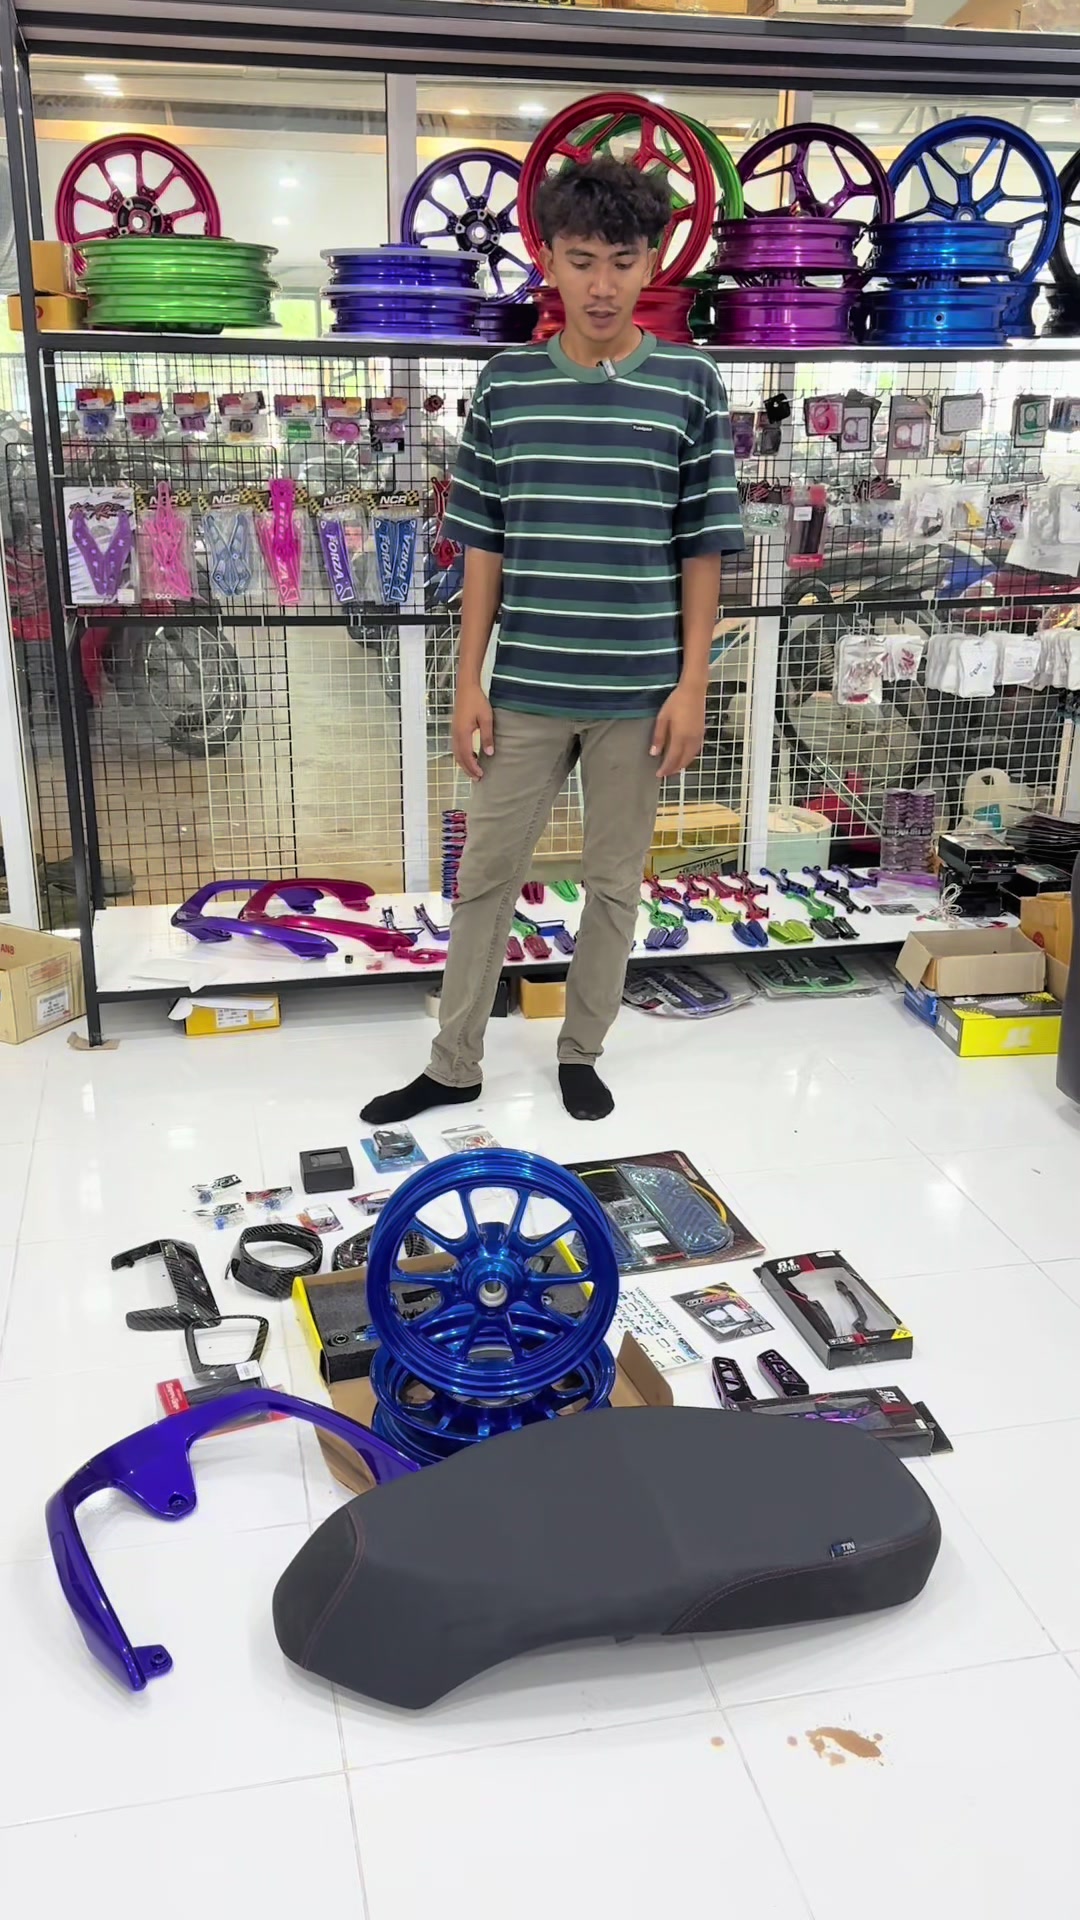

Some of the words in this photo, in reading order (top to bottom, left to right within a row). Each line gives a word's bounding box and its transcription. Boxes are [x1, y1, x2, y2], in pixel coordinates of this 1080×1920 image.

[211, 495, 241, 504] NCR
[323, 495, 351, 506] NCR
[379, 495, 407, 504] NCR
[325, 533, 345, 583] FORZA
[379, 533, 392, 581] FORZA
[396, 533, 416, 581] FORZA
